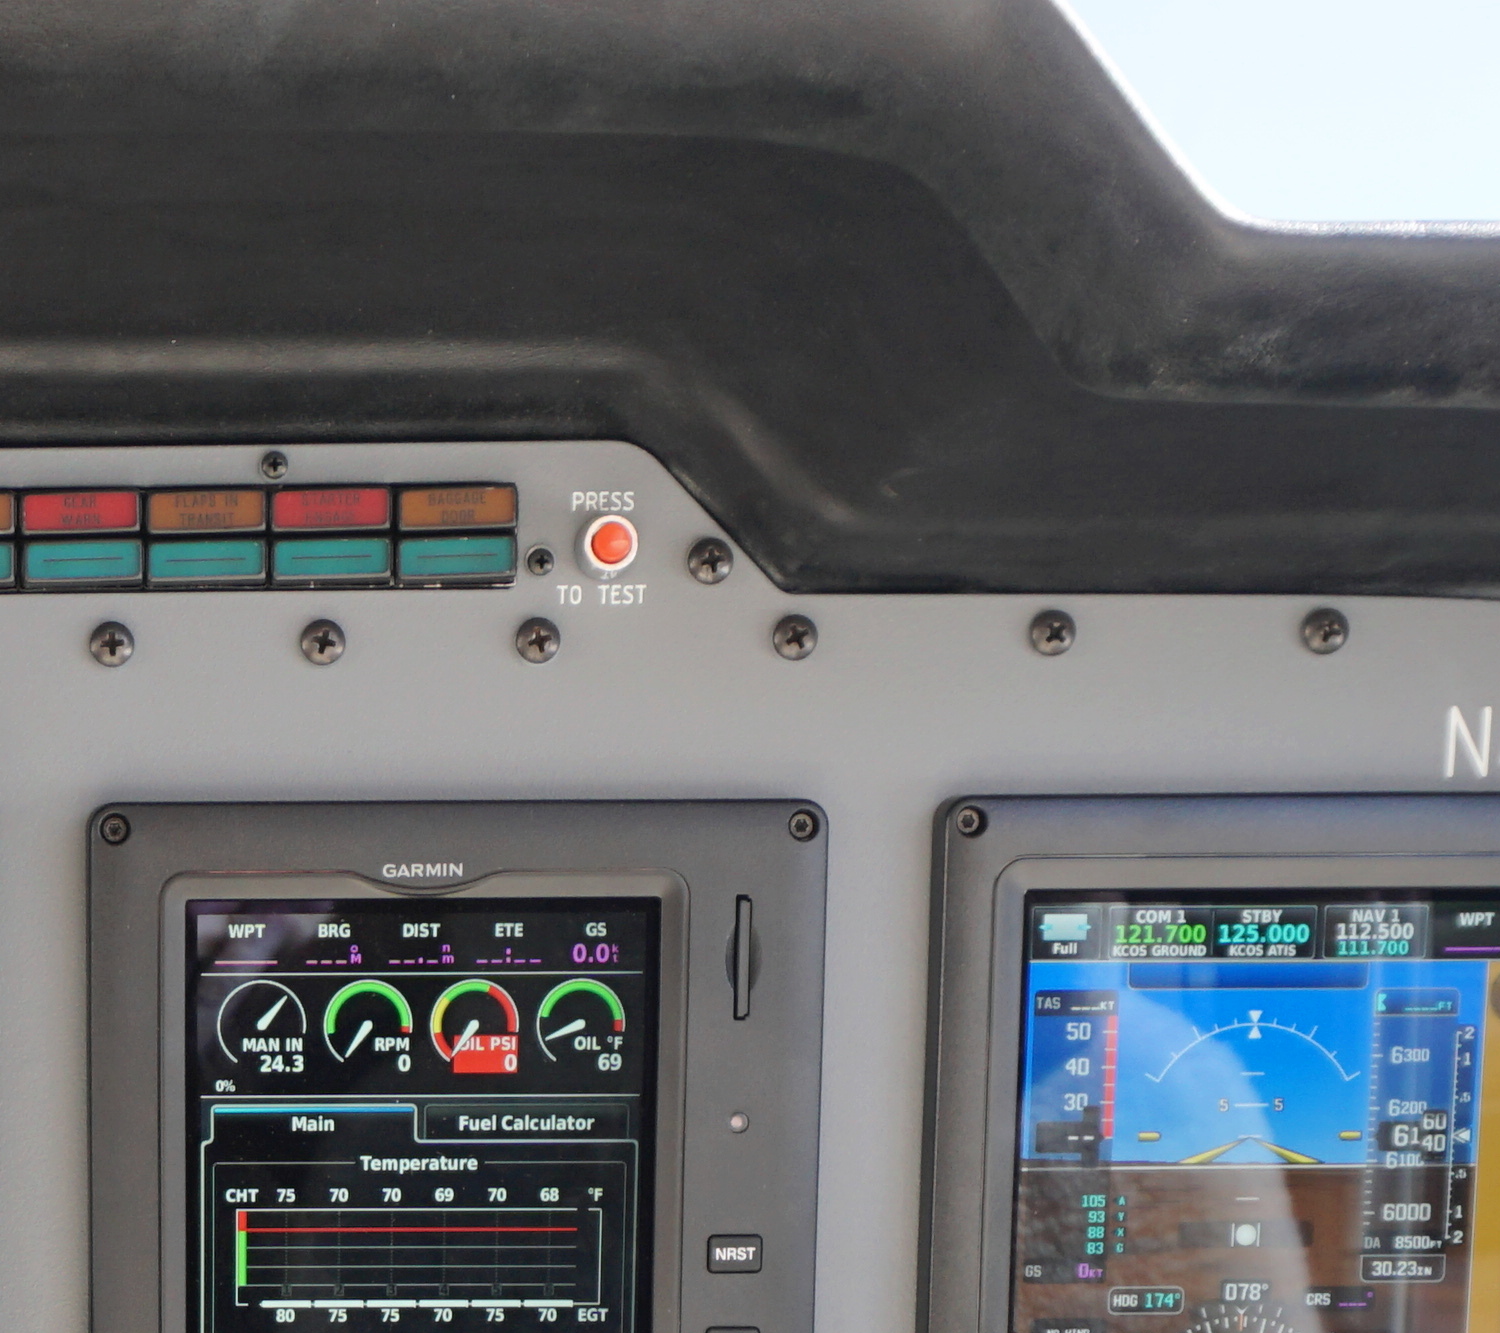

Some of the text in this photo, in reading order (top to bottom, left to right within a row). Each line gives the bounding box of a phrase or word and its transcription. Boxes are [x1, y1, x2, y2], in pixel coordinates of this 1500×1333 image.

[572, 492, 635, 512] PRESS
[557, 584, 645, 604] TO TEST
[382, 863, 463, 879] GARMIN
[1116, 924, 1206, 944] 121.700
[292, 1116, 334, 1132] Main
[459, 1115, 594, 1132] Fuel Calculator
[360, 1155, 478, 1174] Temperature
